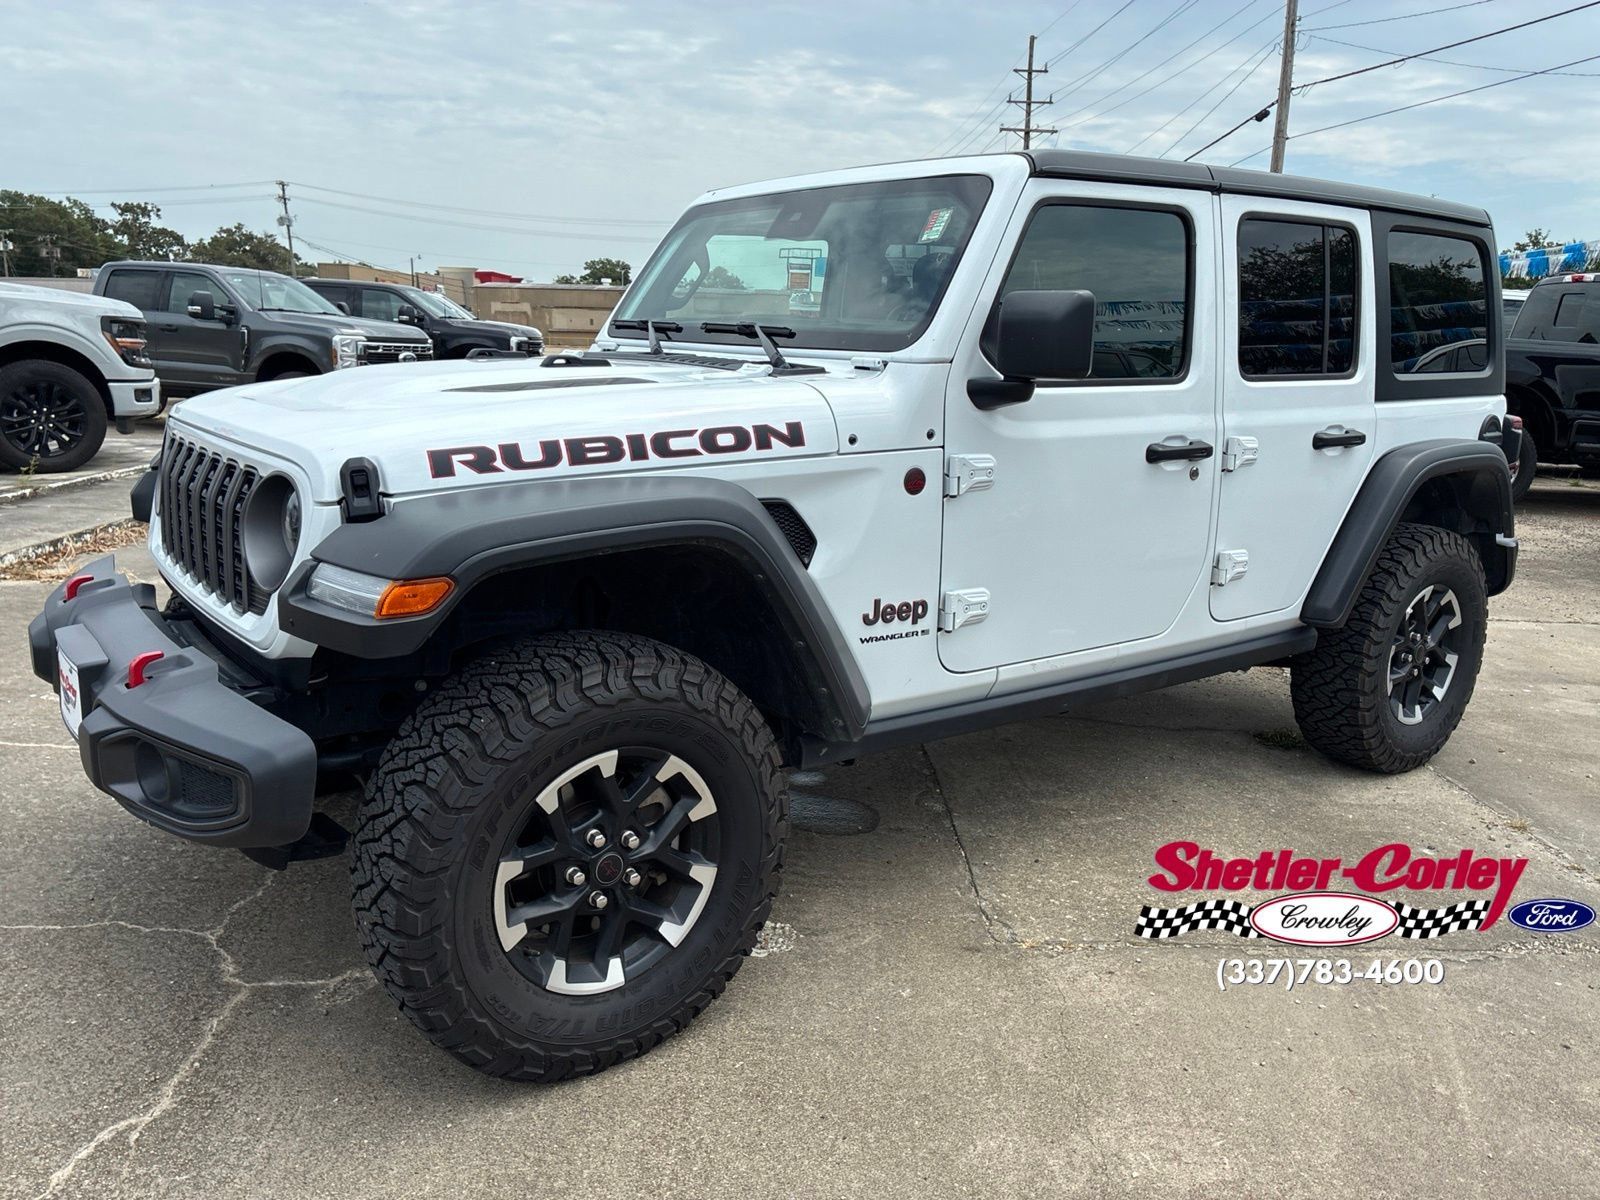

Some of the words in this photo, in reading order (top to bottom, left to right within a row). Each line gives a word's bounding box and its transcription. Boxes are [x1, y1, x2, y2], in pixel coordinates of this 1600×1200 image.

[426, 421, 806, 479] RUBICON
[862, 598, 929, 626] Jeep
[859, 630, 919, 645] WRANGLER
